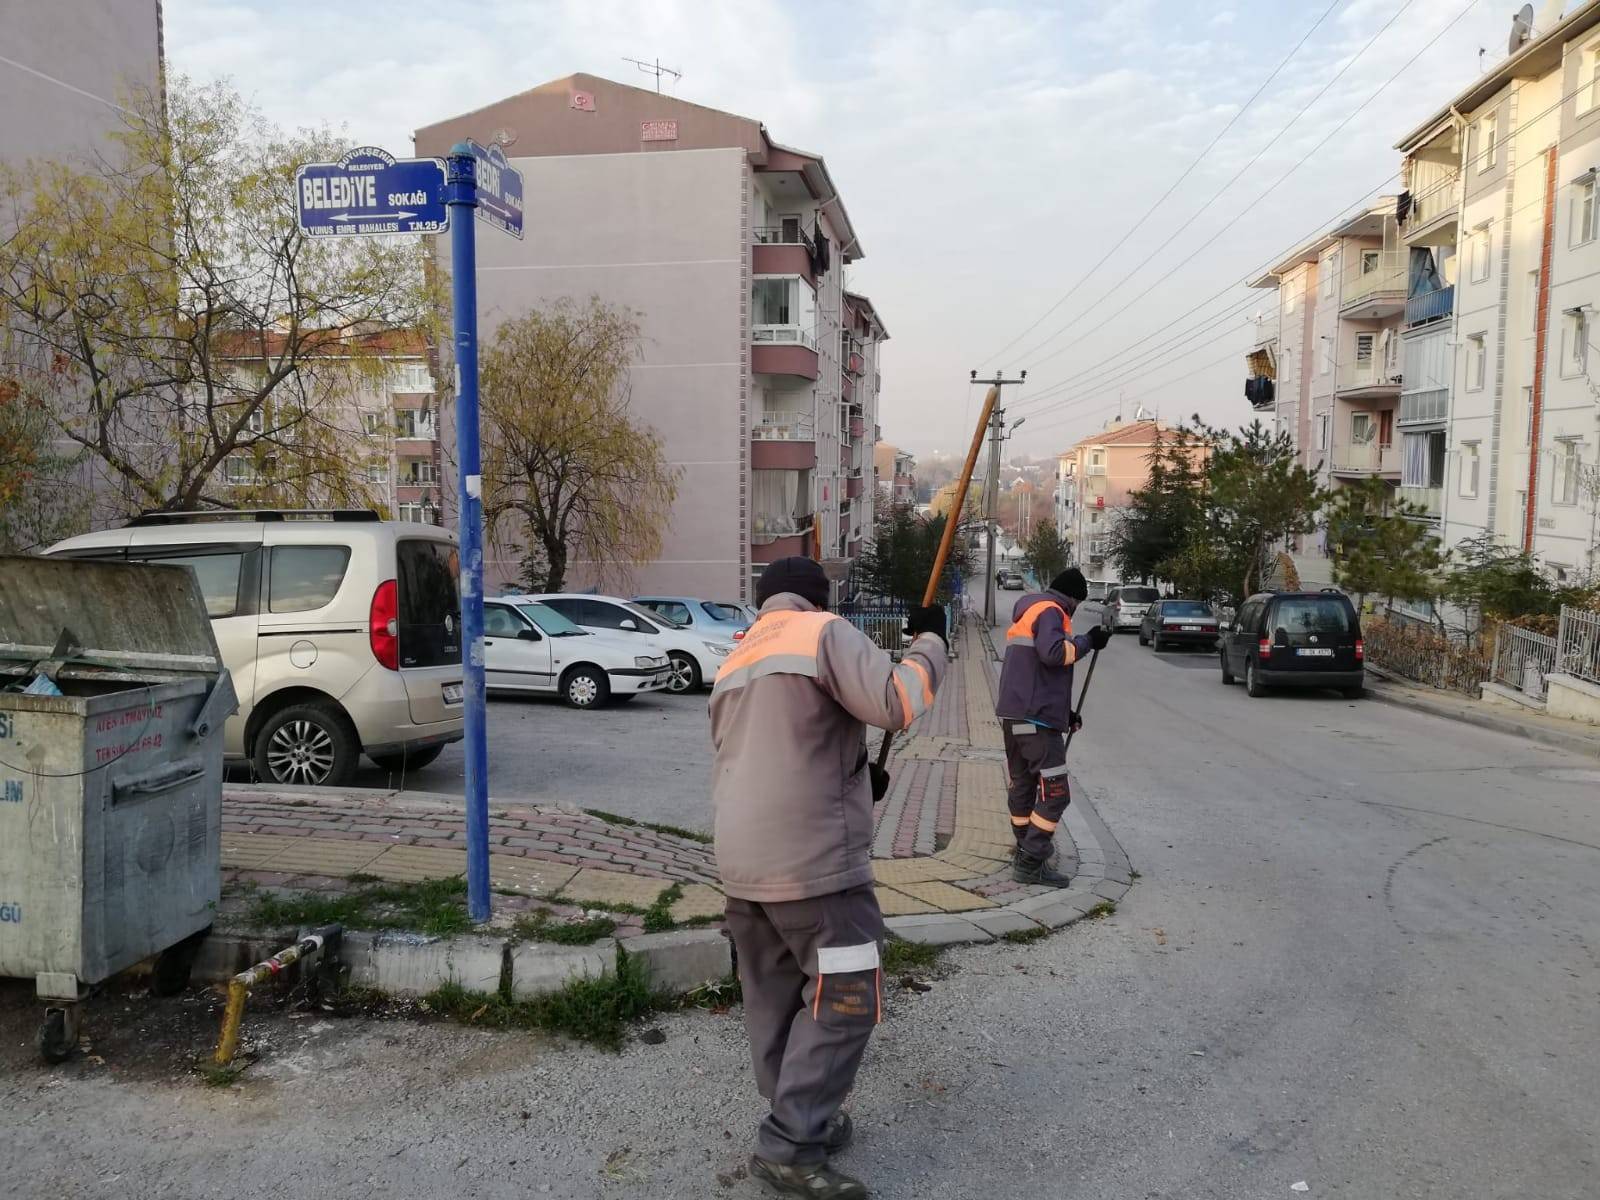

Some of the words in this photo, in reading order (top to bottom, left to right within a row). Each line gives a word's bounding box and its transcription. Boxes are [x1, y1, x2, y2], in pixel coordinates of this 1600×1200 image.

[388, 190, 427, 207] SOKAĞI
[309, 225, 333, 235] YUNUS
[336, 224, 356, 234] EMRE
